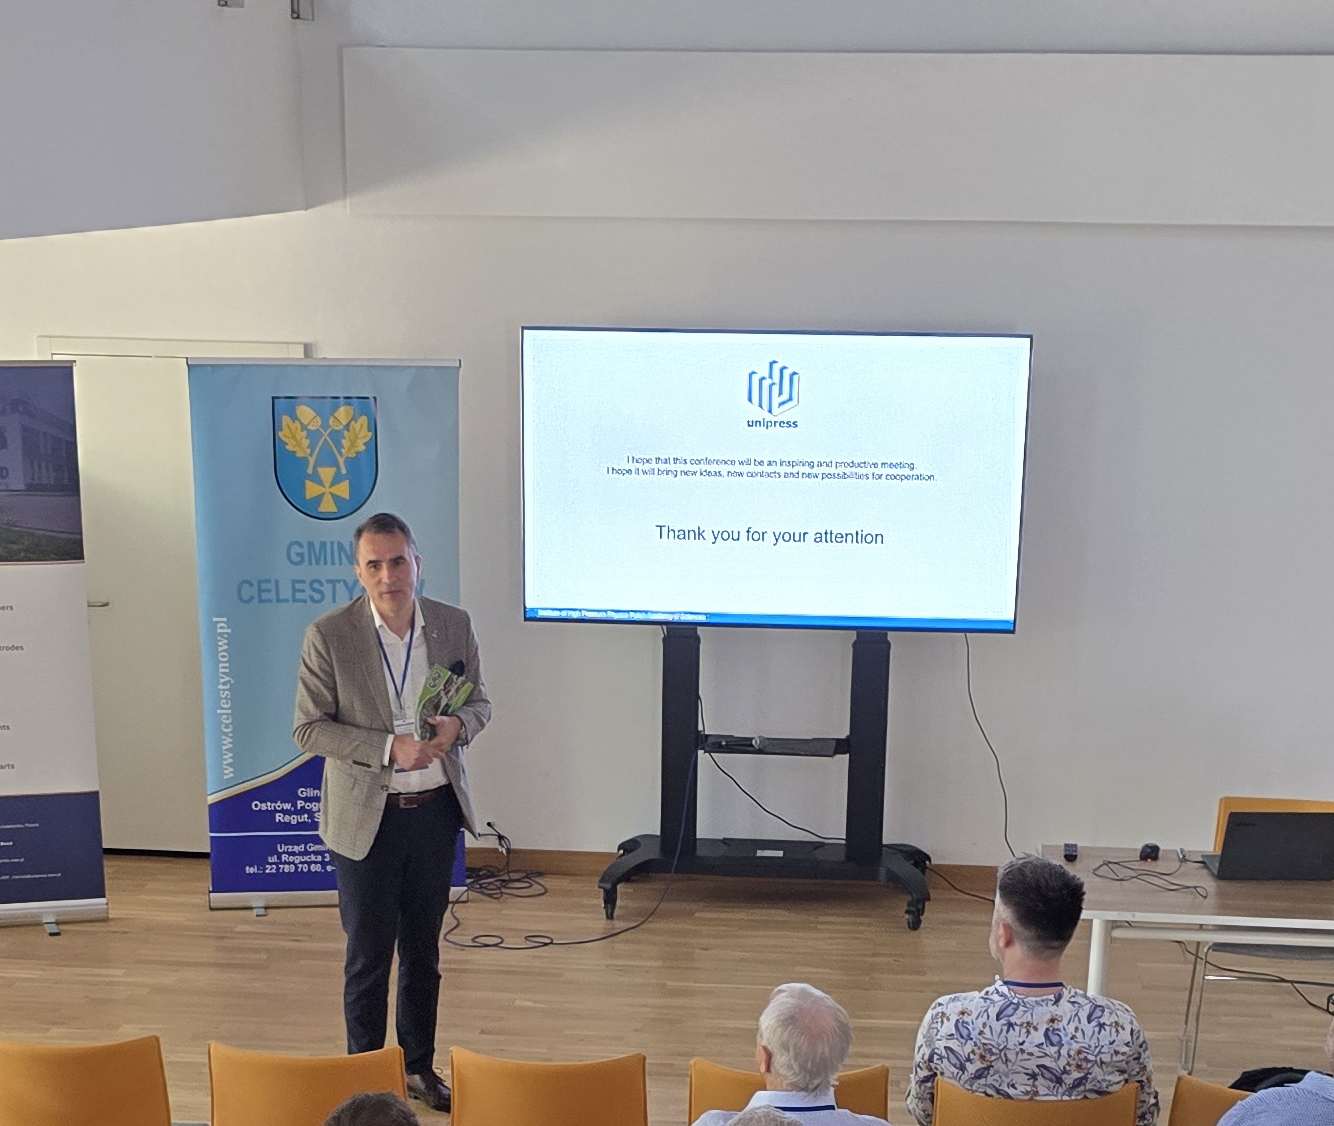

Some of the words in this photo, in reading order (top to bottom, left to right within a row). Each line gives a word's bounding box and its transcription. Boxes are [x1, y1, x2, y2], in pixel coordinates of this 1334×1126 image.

[747, 418, 799, 430] unipress
[632, 456, 652, 466] hope
[673, 457, 687, 465] this
[689, 457, 736, 466] conference
[738, 458, 751, 466] will
[779, 459, 814, 469] inspiring
[835, 460, 878, 470] productive
[612, 467, 632, 477] hope
[657, 468, 678, 478] bring
[746, 470, 781, 478] contacts
[783, 471, 799, 479] and
[872, 472, 883, 480] for
[655, 525, 706, 541] Thank
[711, 529, 740, 544] you
[746, 527, 767, 542] for
[772, 530, 808, 546] your
[813, 529, 884, 545] attention
[286, 540, 354, 567] GMIN
[237, 578, 426, 604] CELESTY
[213, 616, 234, 780] www.celestynow.pl
[297, 788, 321, 797] Glin
[251, 801, 294, 811] Ostrów,
[275, 813, 311, 824] Regut,
[277, 843, 305, 853] Urząd
[306, 843, 331, 852] Gmin
[281, 854, 322, 863] Regucka
[265, 865, 276, 873] 22
[279, 864, 295, 872] 789
[297, 864, 308, 872] 70
